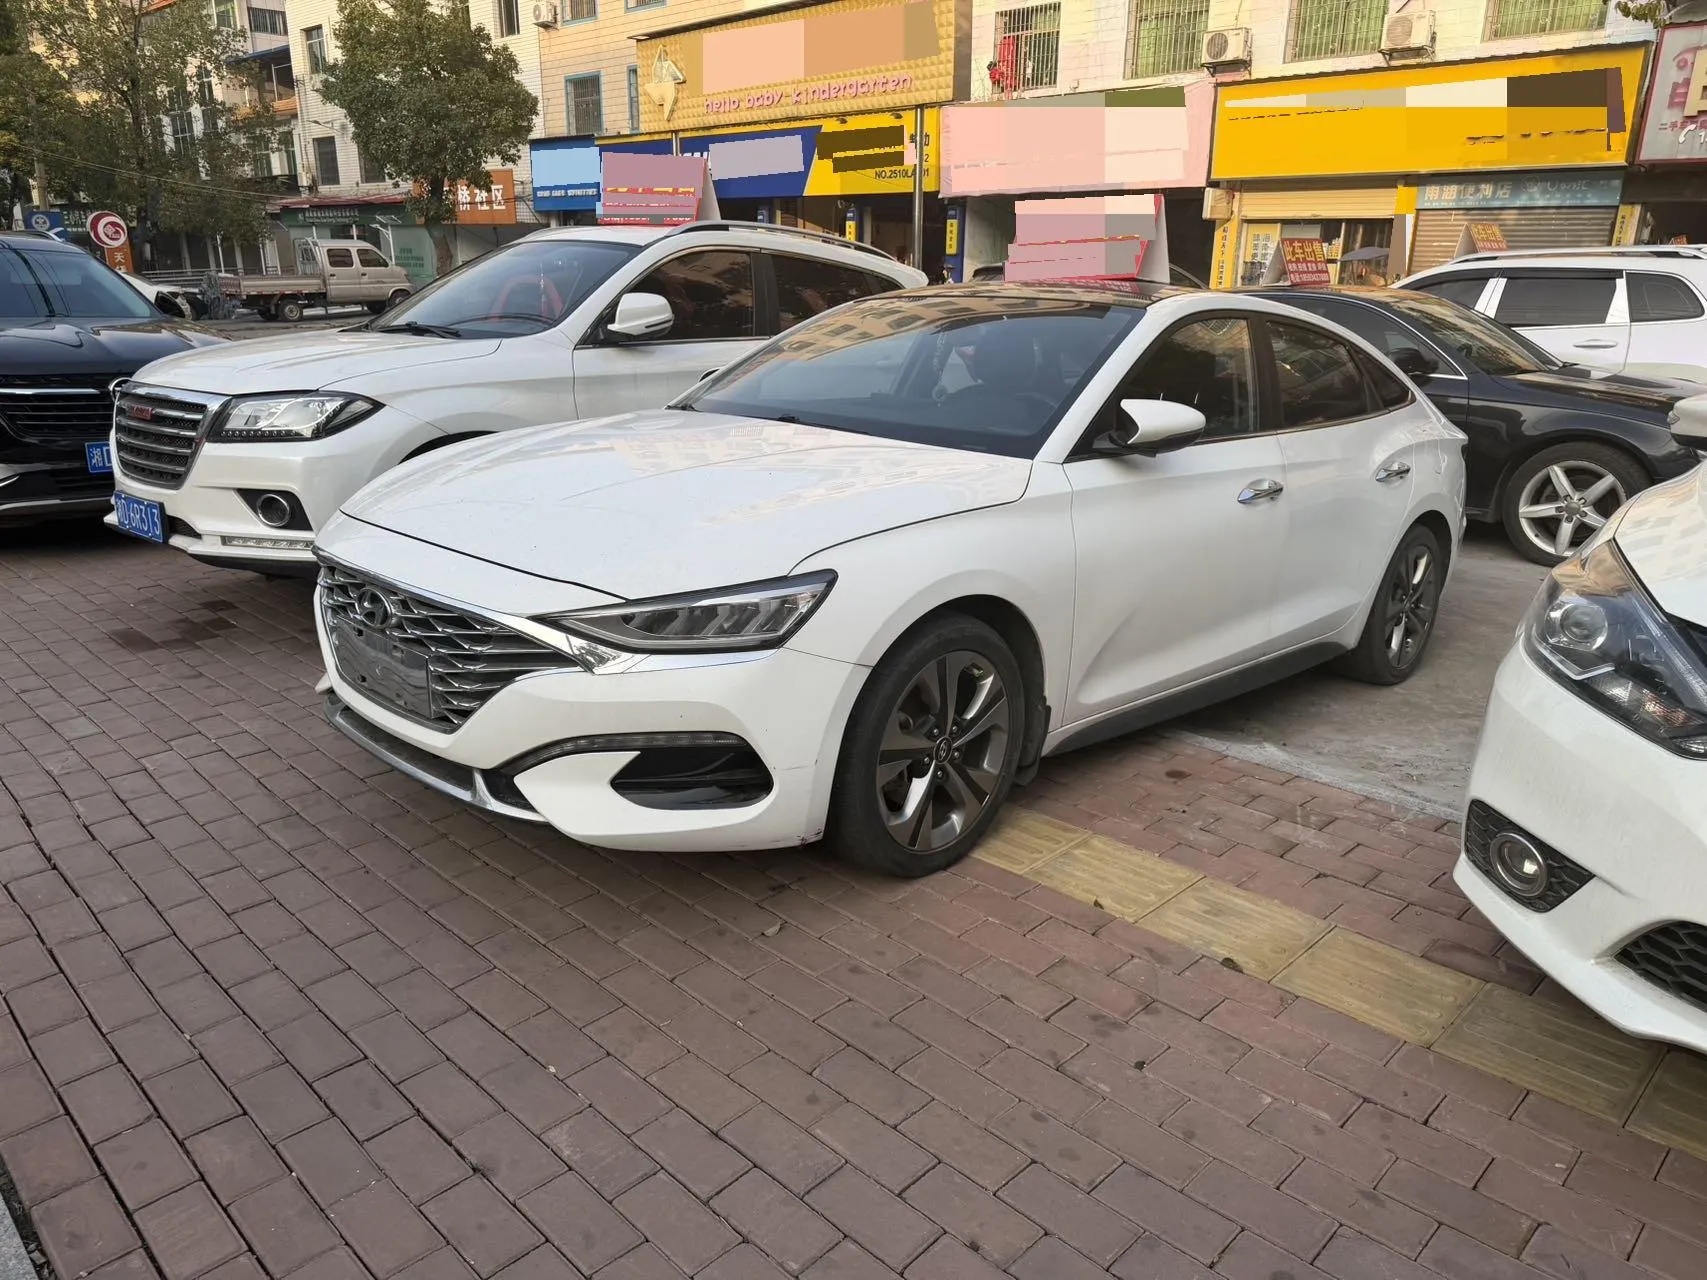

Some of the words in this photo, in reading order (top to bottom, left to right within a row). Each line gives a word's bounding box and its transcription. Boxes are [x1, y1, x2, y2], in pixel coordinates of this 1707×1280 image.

[704, 97, 740, 114] hello
[745, 90, 784, 110] baby
[793, 73, 914, 105] kindergarten
[443, 184, 507, 211] 桥社区
[1284, 240, 1325, 261] 此车出售
